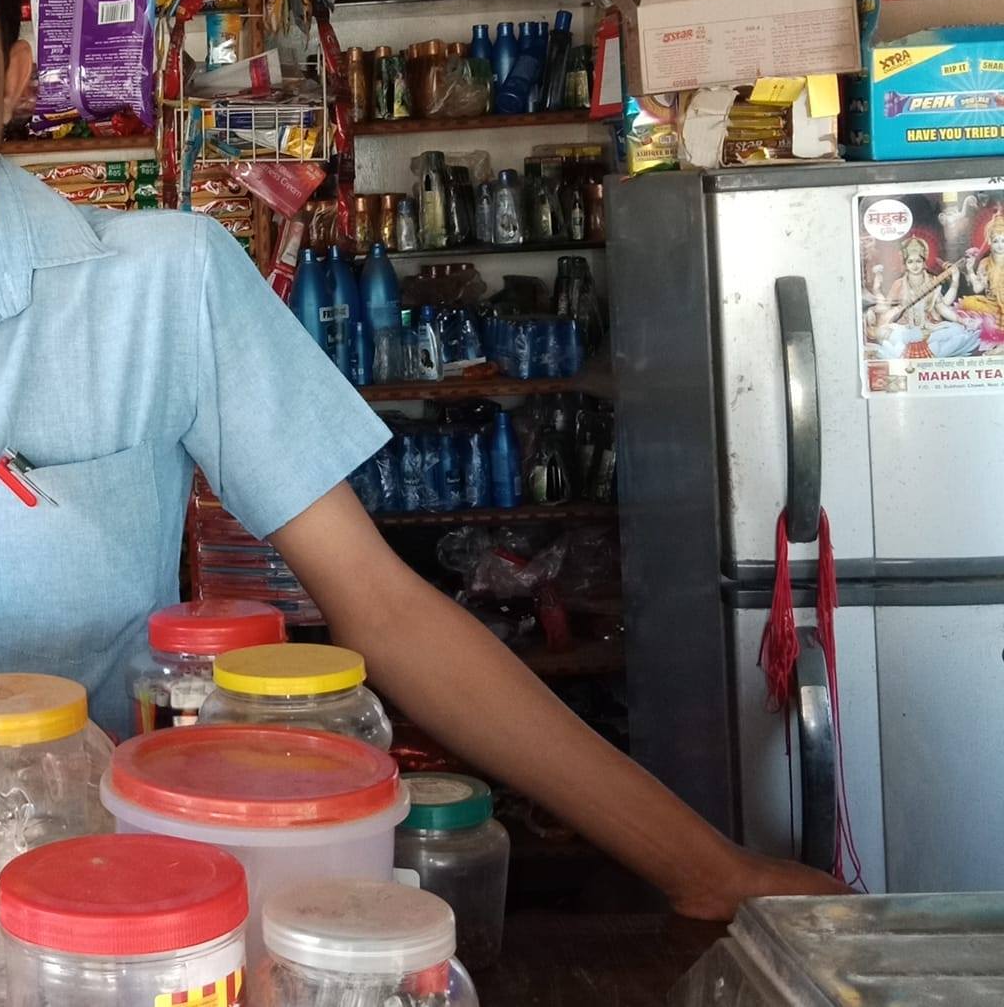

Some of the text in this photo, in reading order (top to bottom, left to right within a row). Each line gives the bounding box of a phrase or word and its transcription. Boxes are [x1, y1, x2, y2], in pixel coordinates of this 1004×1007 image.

[879, 49, 911, 70] XTRA
[944, 64, 966, 73] RIP IT
[907, 127, 998, 142] HAVE YOU TRIED
[918, 369, 1003, 381] MAHAK TEA
